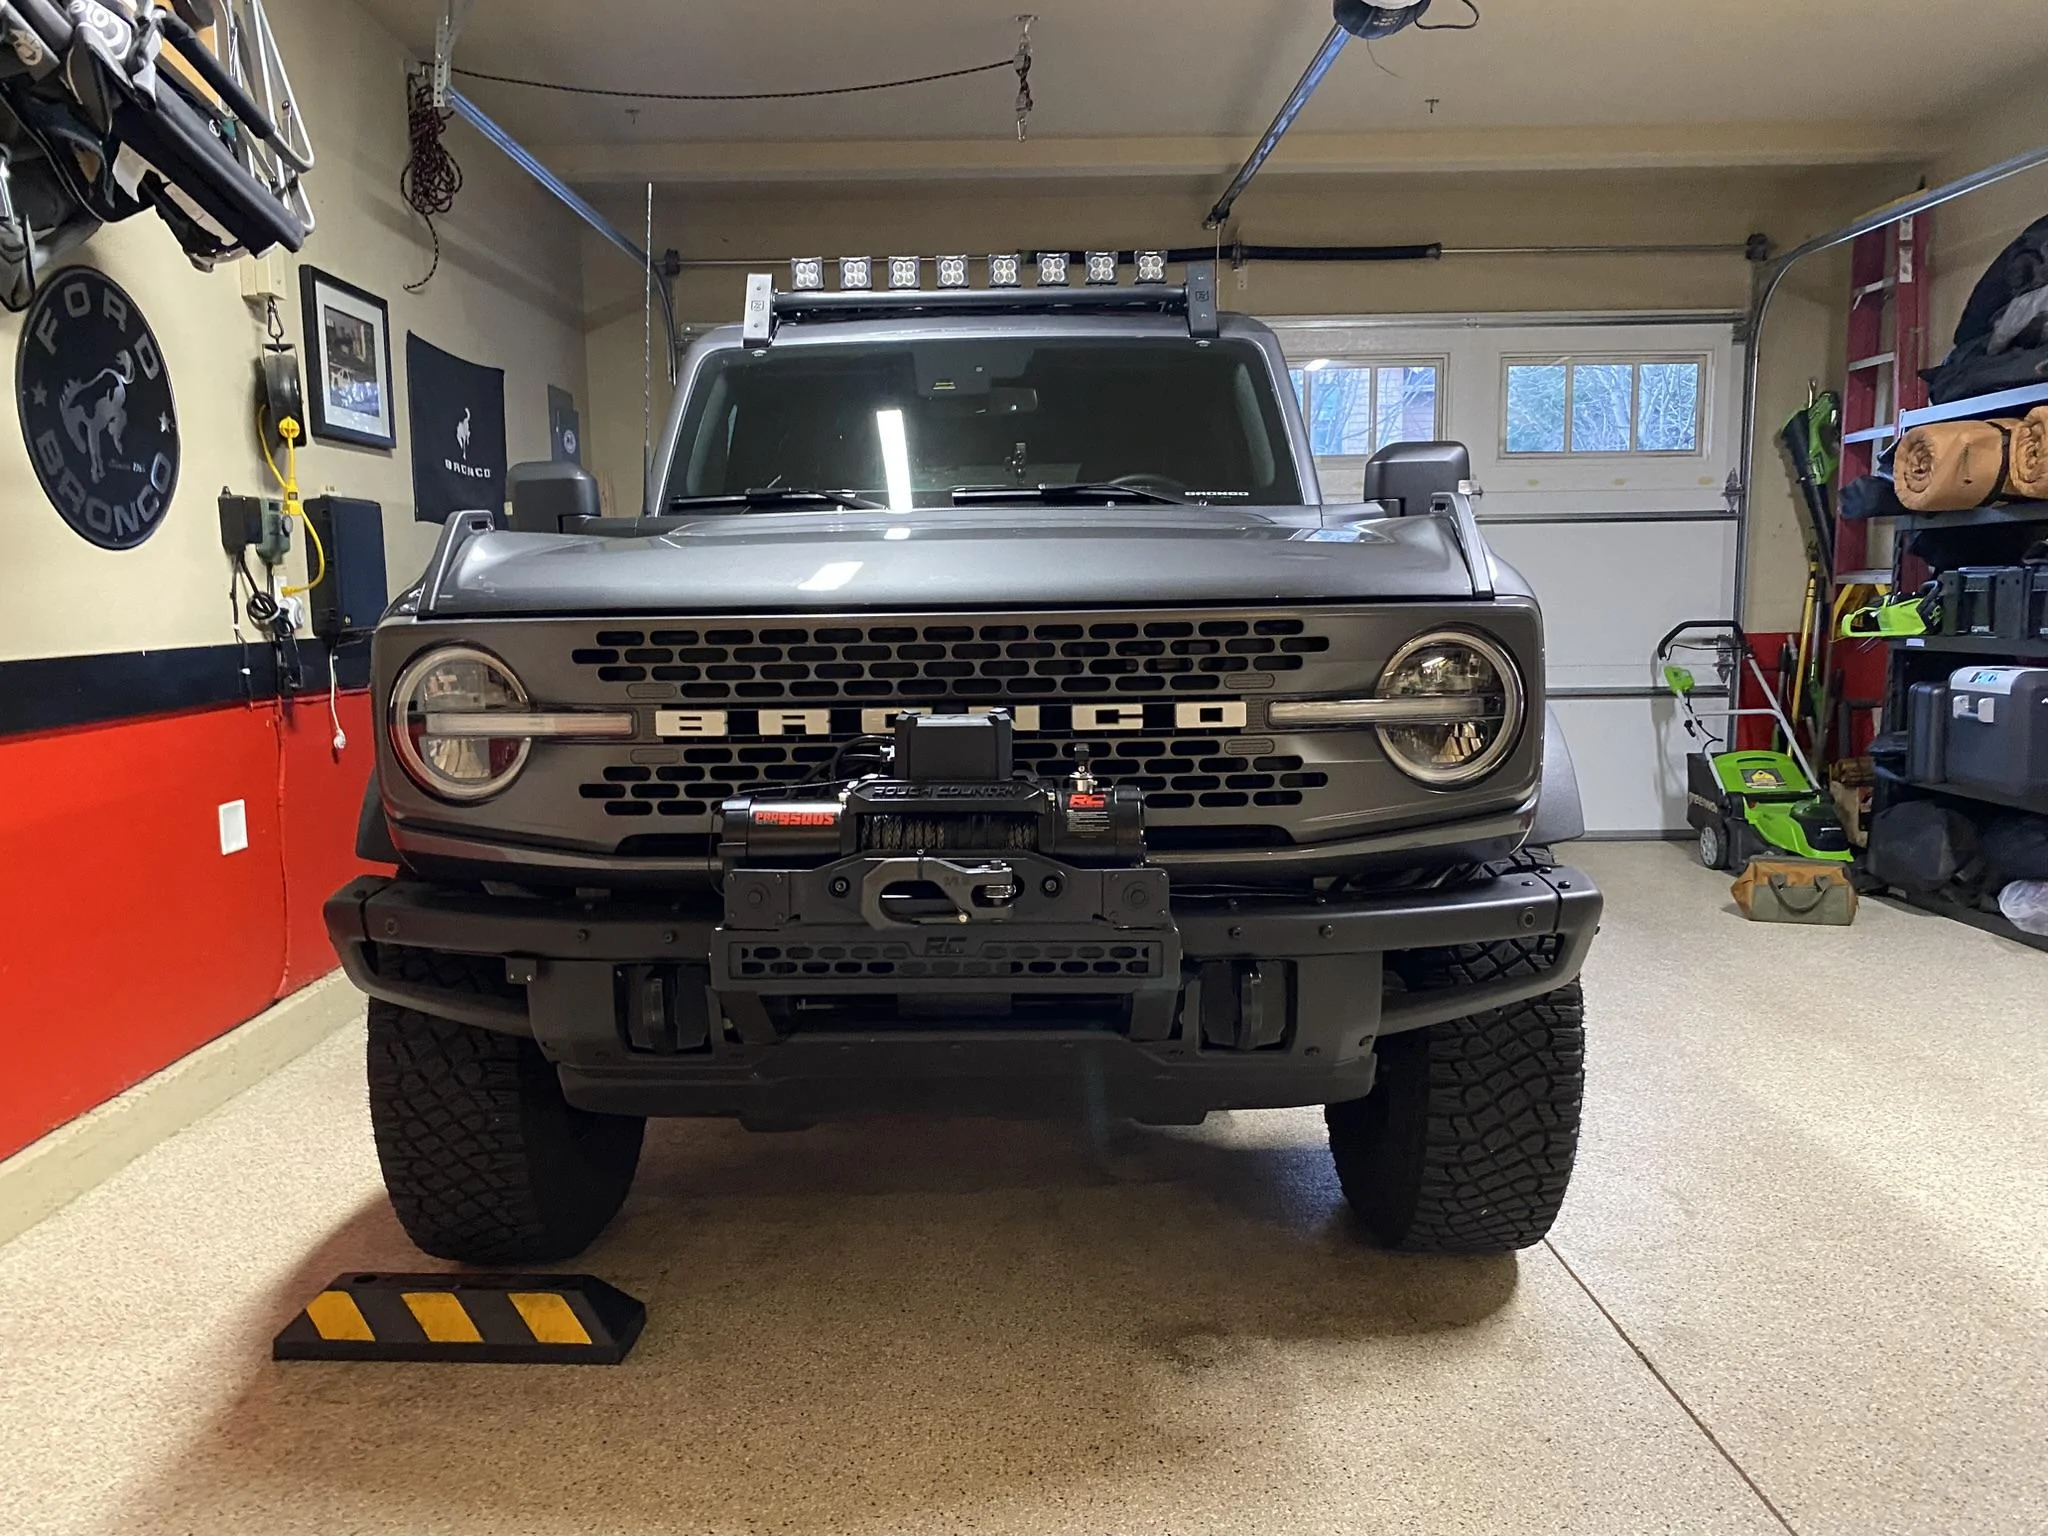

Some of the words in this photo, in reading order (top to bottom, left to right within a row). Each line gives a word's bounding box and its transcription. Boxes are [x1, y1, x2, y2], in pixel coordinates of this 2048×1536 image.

[36, 282, 160, 380] FORD
[445, 459, 490, 478] BRONCO
[36, 429, 171, 537] BRONCO
[1069, 794, 1106, 807] RC
[925, 936, 967, 955] RC
